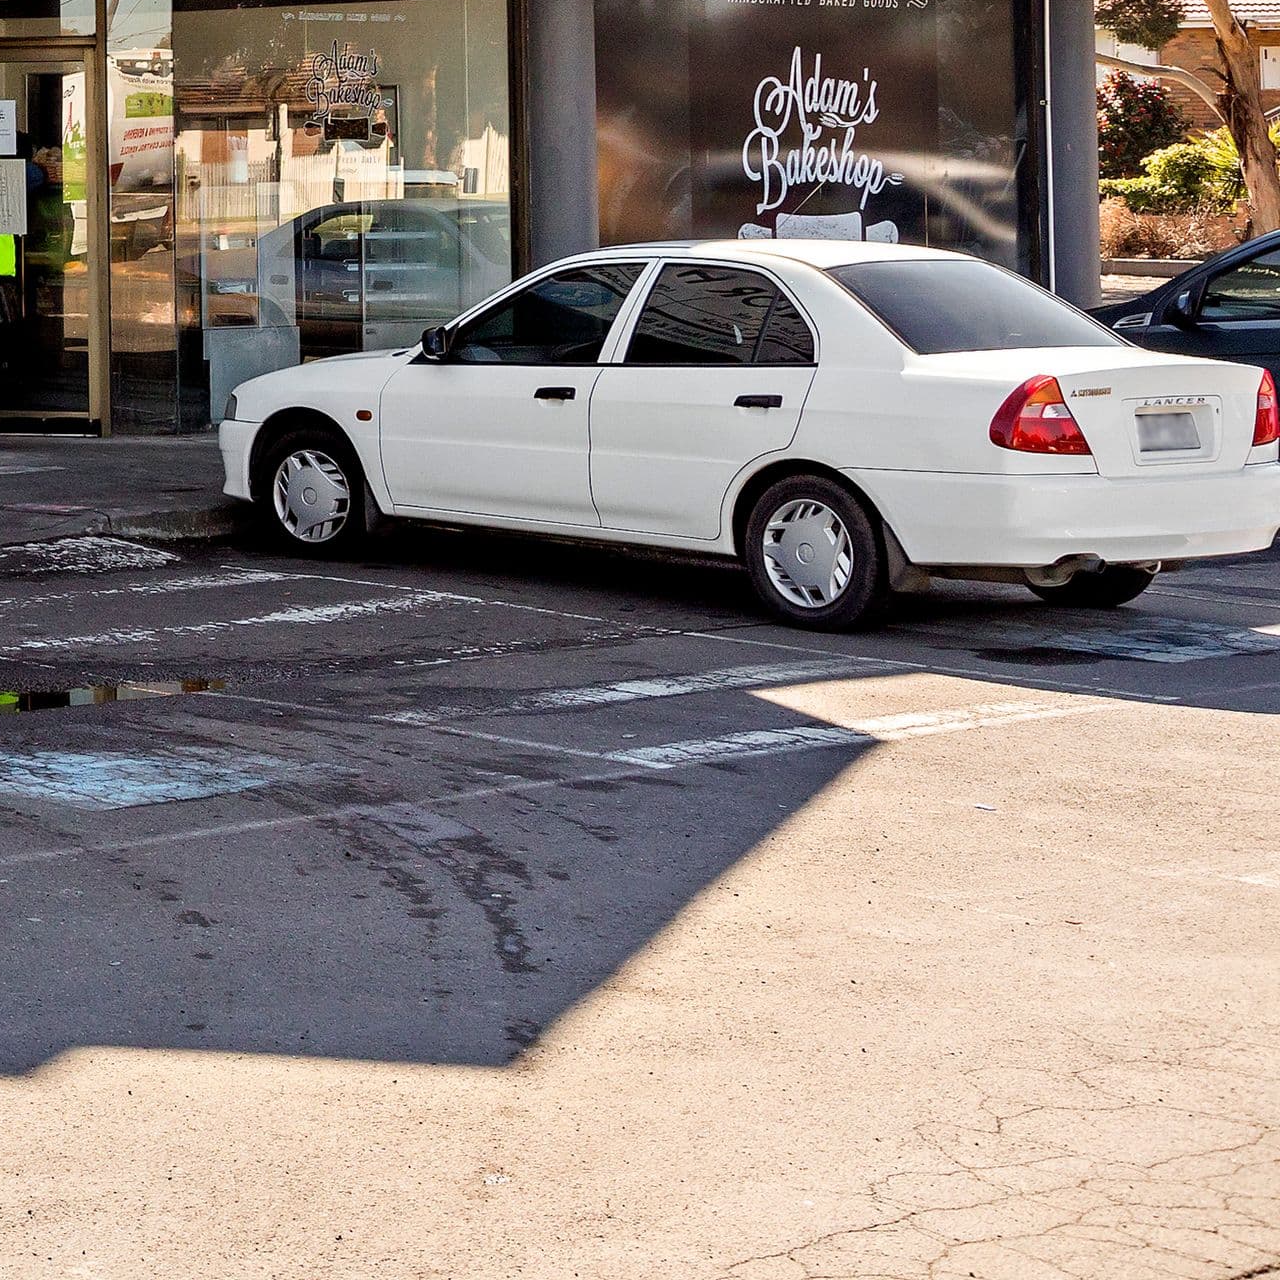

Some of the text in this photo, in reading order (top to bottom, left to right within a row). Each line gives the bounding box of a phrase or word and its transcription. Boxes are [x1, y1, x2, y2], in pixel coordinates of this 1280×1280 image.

[313, 39, 378, 83] Adam's
[306, 77, 382, 120] Bakeshop
[754, 46, 879, 140] Adam's
[743, 126, 886, 216] Bakeshop
[1144, 397, 1206, 406] LANCER
